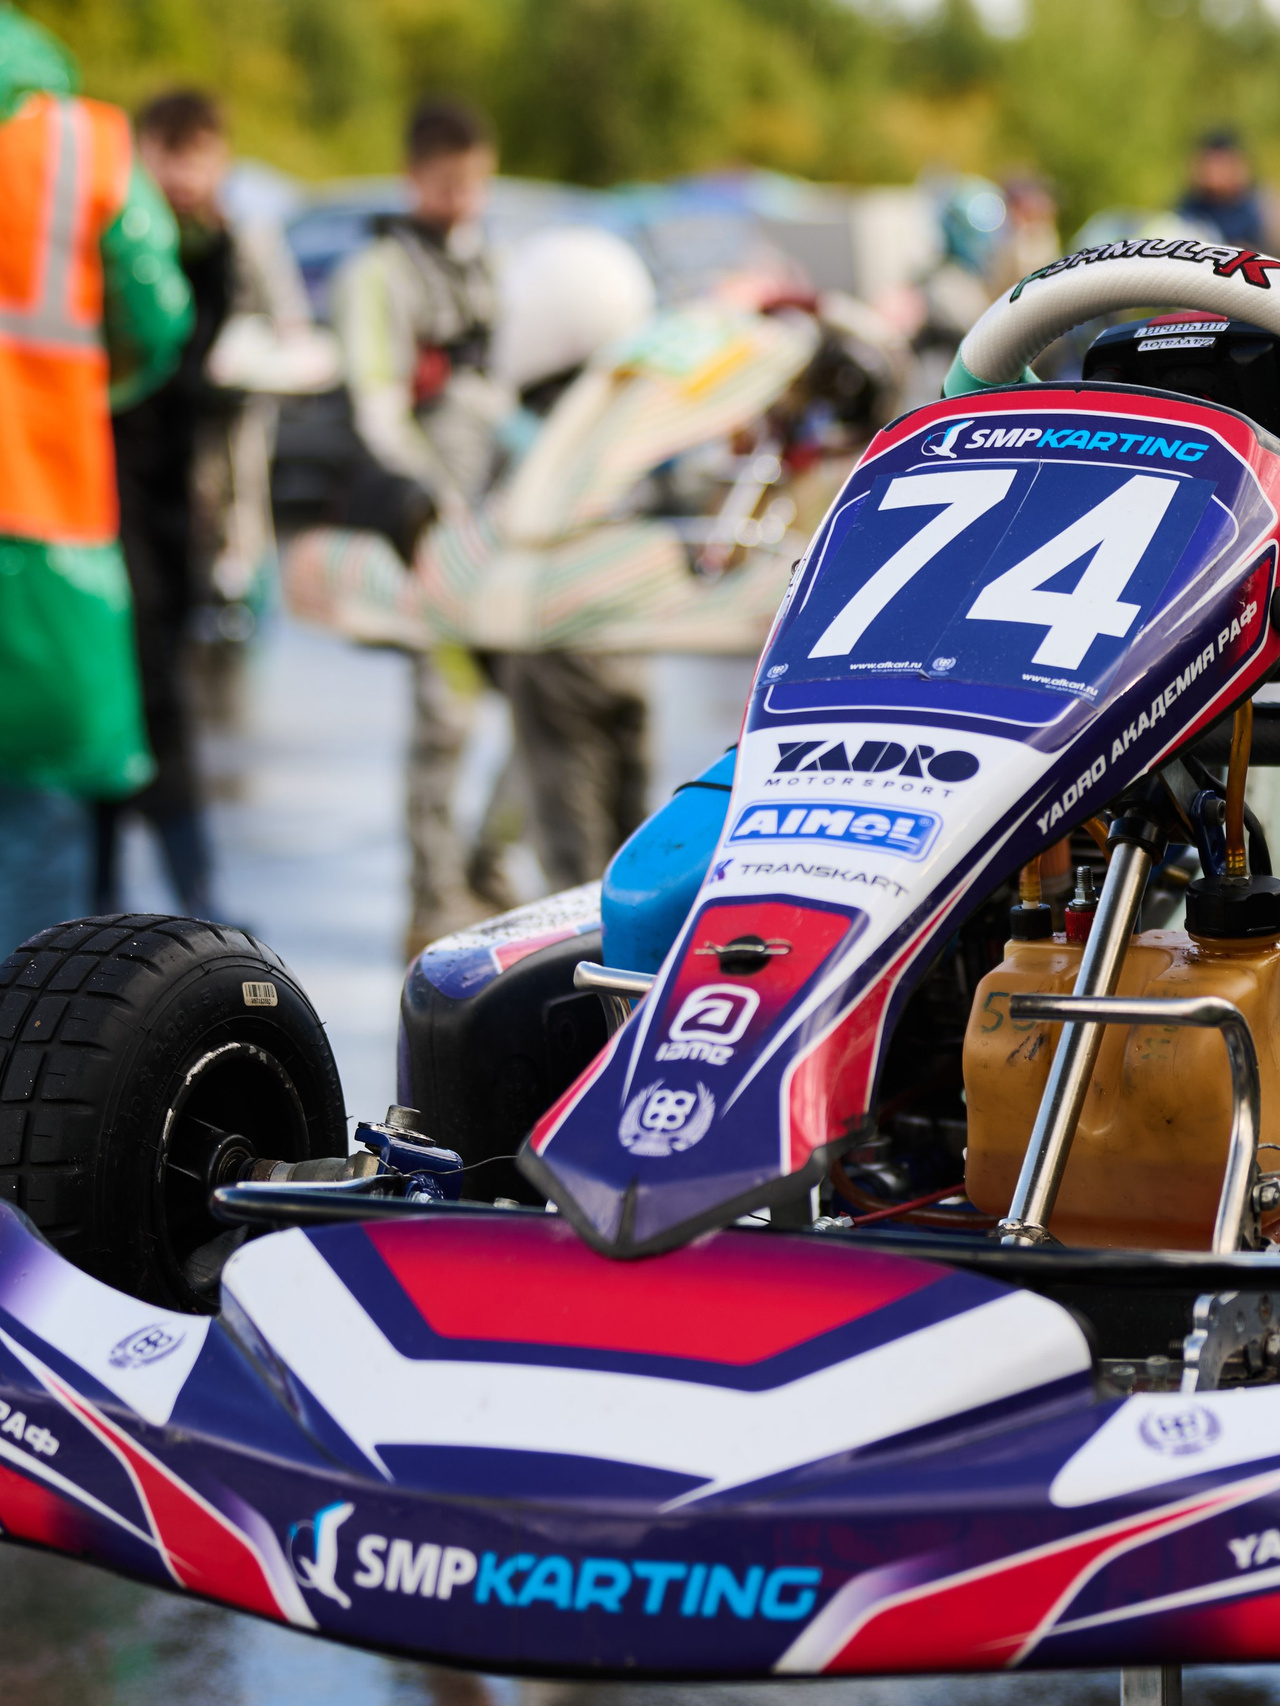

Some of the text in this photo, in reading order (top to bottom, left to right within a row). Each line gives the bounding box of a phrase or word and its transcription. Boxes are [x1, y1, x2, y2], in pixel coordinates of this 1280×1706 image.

[807, 469, 1181, 670] 74
[1036, 755, 1107, 836] YADRO
[1111, 643, 1215, 765] АКАДЕМИЯ
[1217, 600, 1258, 654] РАФ
[764, 777, 955, 798] MOTORSPORT
[741, 864, 909, 897] TRANSKART
